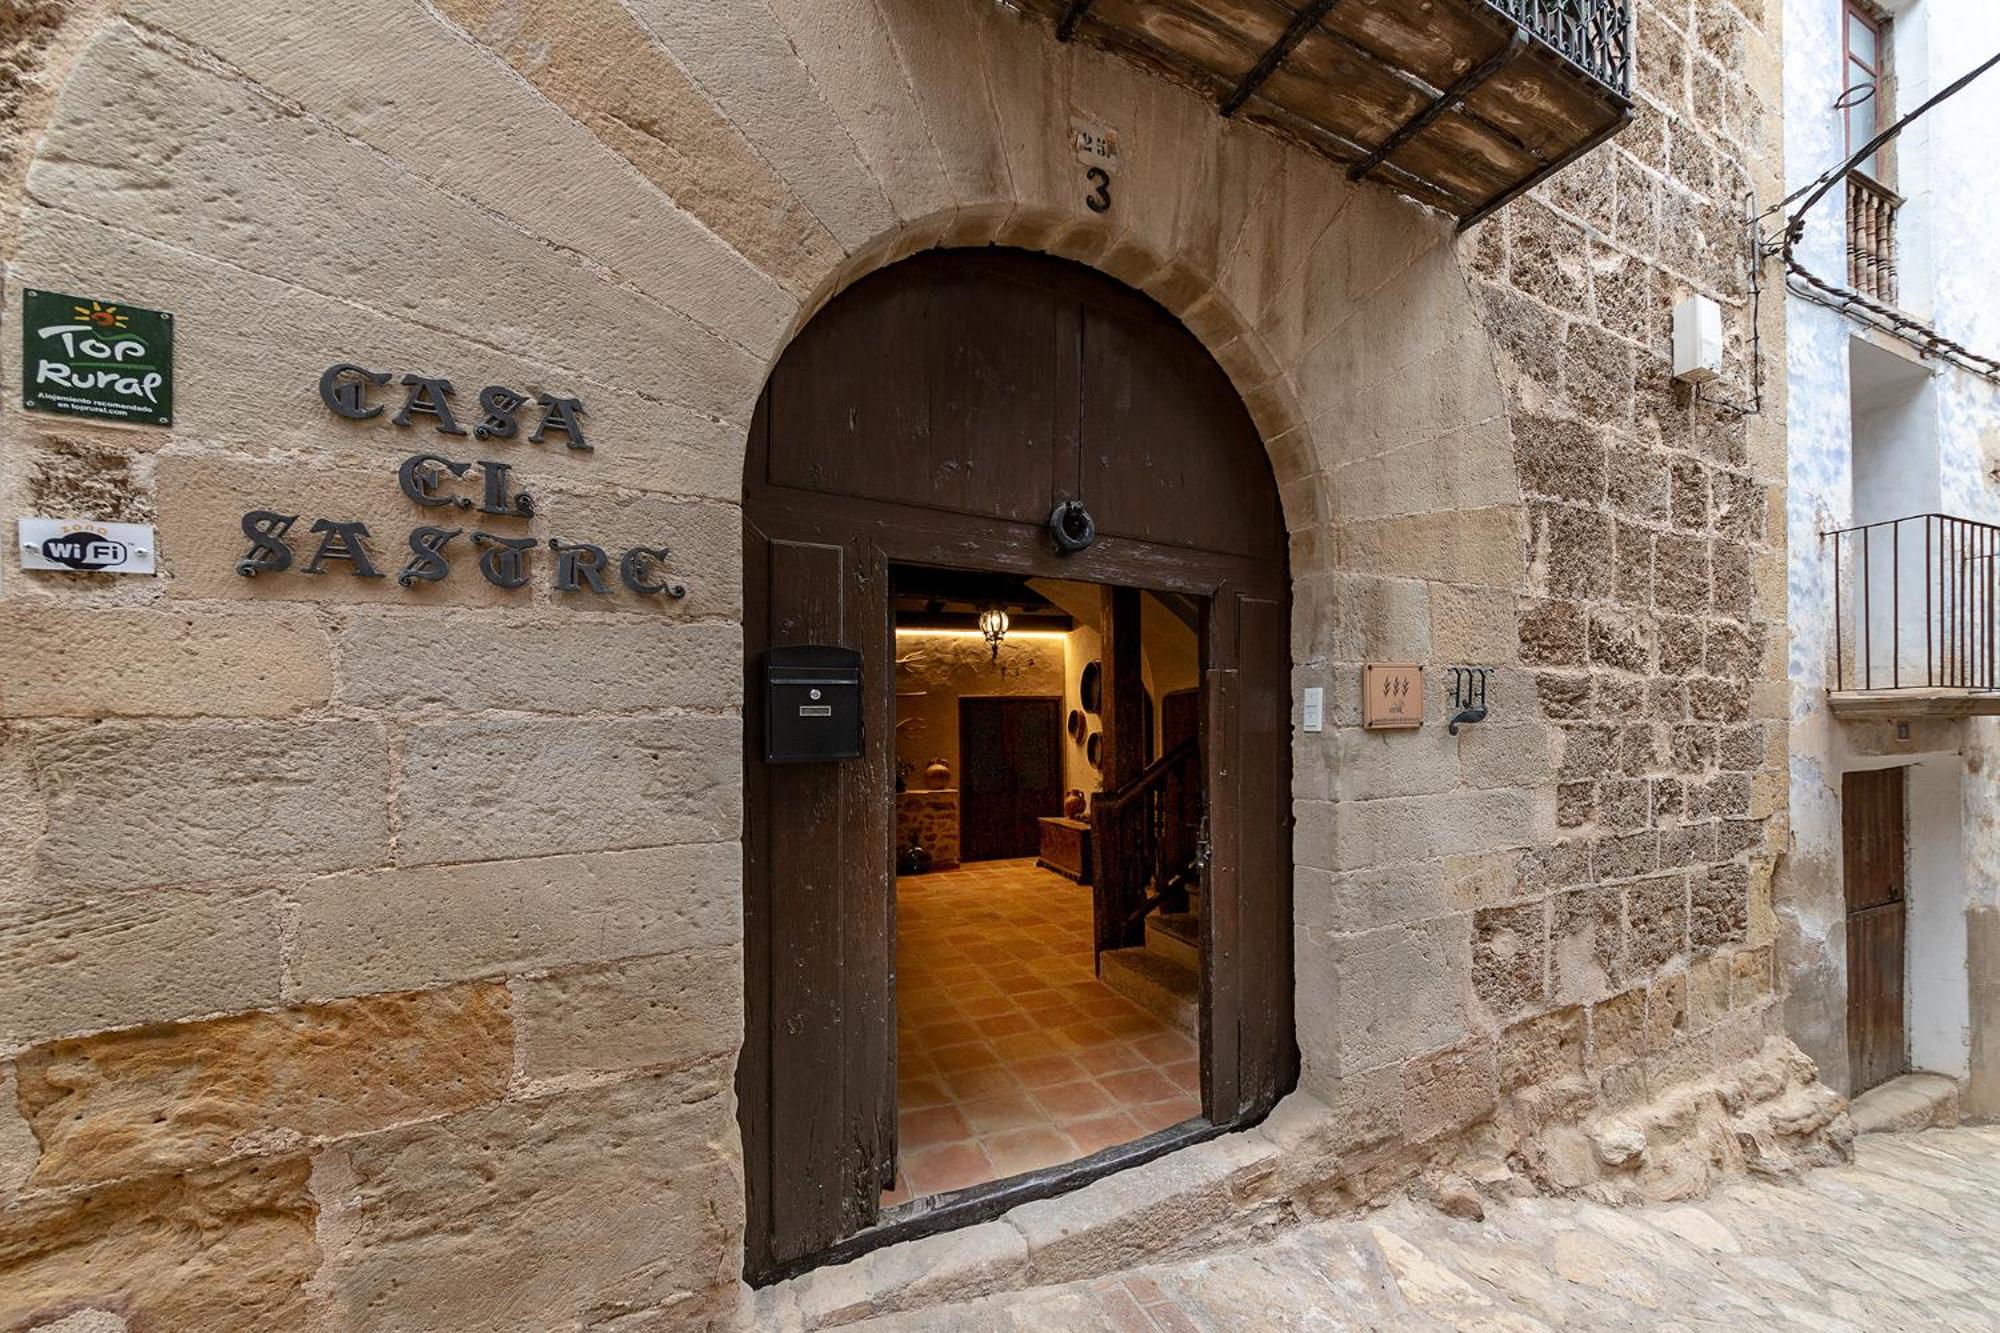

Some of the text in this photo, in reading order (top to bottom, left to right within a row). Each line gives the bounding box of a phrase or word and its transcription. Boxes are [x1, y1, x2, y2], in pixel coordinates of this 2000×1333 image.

[1086, 167, 1111, 214] 3
[37, 325, 147, 361] Top
[36, 360, 162, 403] Rural
[38, 392, 153, 413] Alojamiento recomendado
[71, 403, 128, 416] toprural.com
[319, 363, 595, 452] CASA
[236, 510, 686, 599] SASTRE
